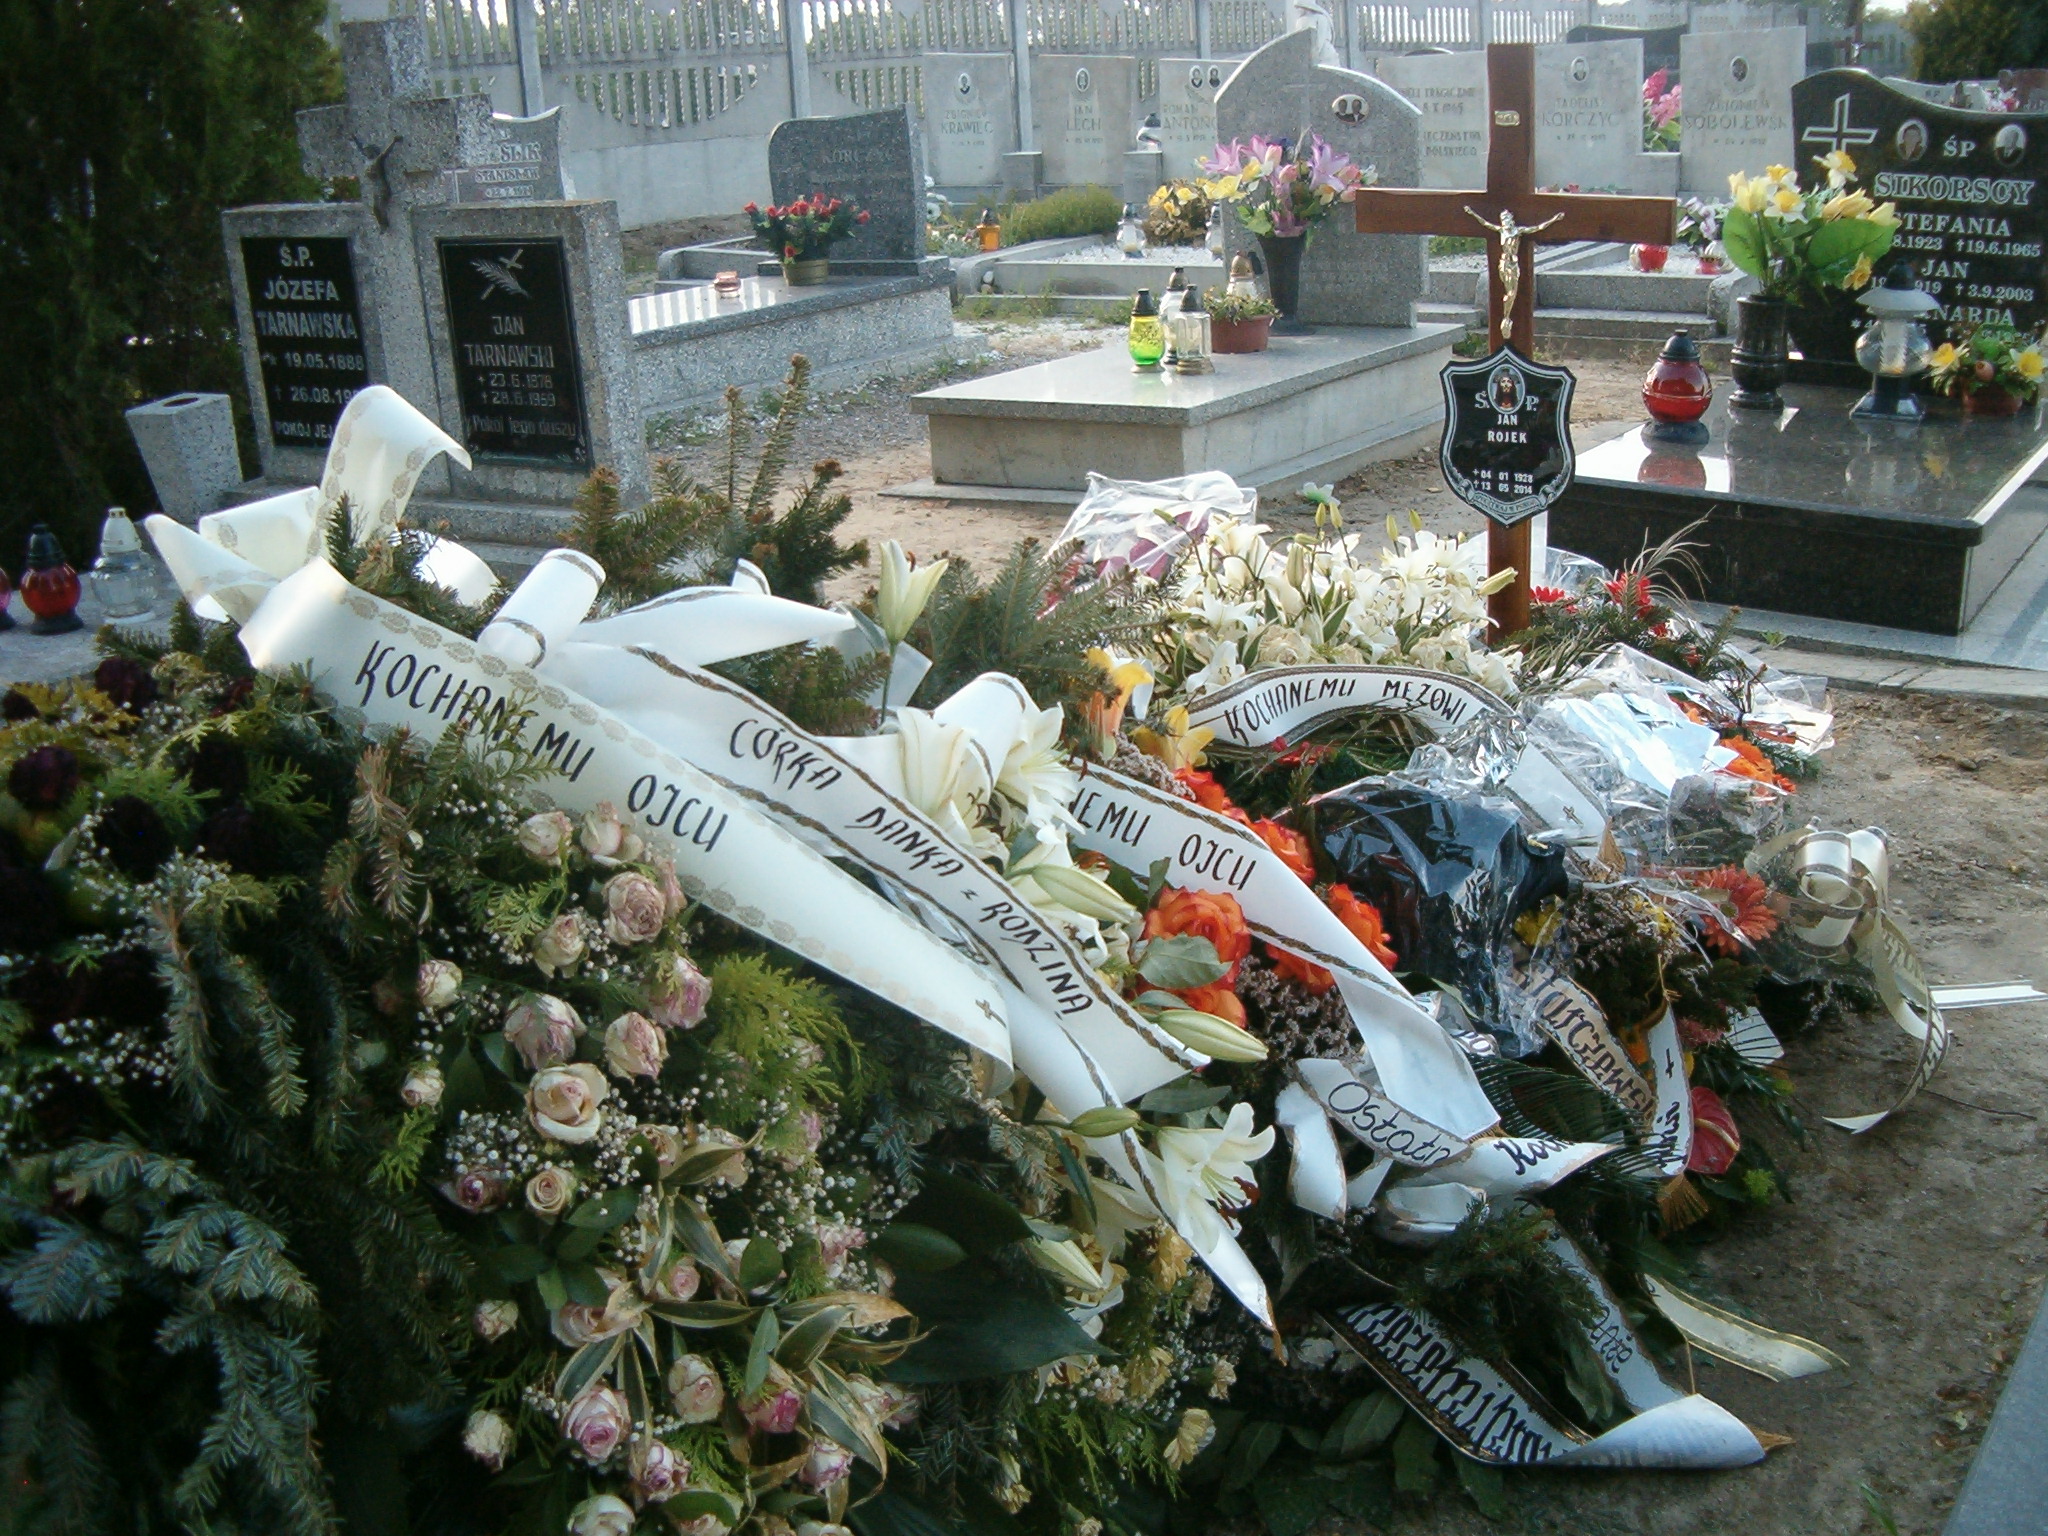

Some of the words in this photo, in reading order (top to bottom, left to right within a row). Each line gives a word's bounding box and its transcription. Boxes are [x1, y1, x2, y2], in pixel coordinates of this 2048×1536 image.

[1066, 117, 1102, 131] LECH
[1873, 171, 2036, 206] SIKORSCY
[1920, 258, 1970, 279] JAN
[263, 275, 340, 301] JÓZEFA
[256, 311, 358, 339] TARNAWSKA
[491, 315, 526, 336] JAN
[463, 343, 556, 369] TARNAWSKI
[1496, 414, 1518, 427] JAN
[1487, 430, 1528, 445] ROJEK
[1223, 678, 1356, 746] KOCHANEMU
[627, 774, 729, 854] OJCU
[845, 806, 965, 878] DANKA
[1179, 833, 1258, 891] OJCU
